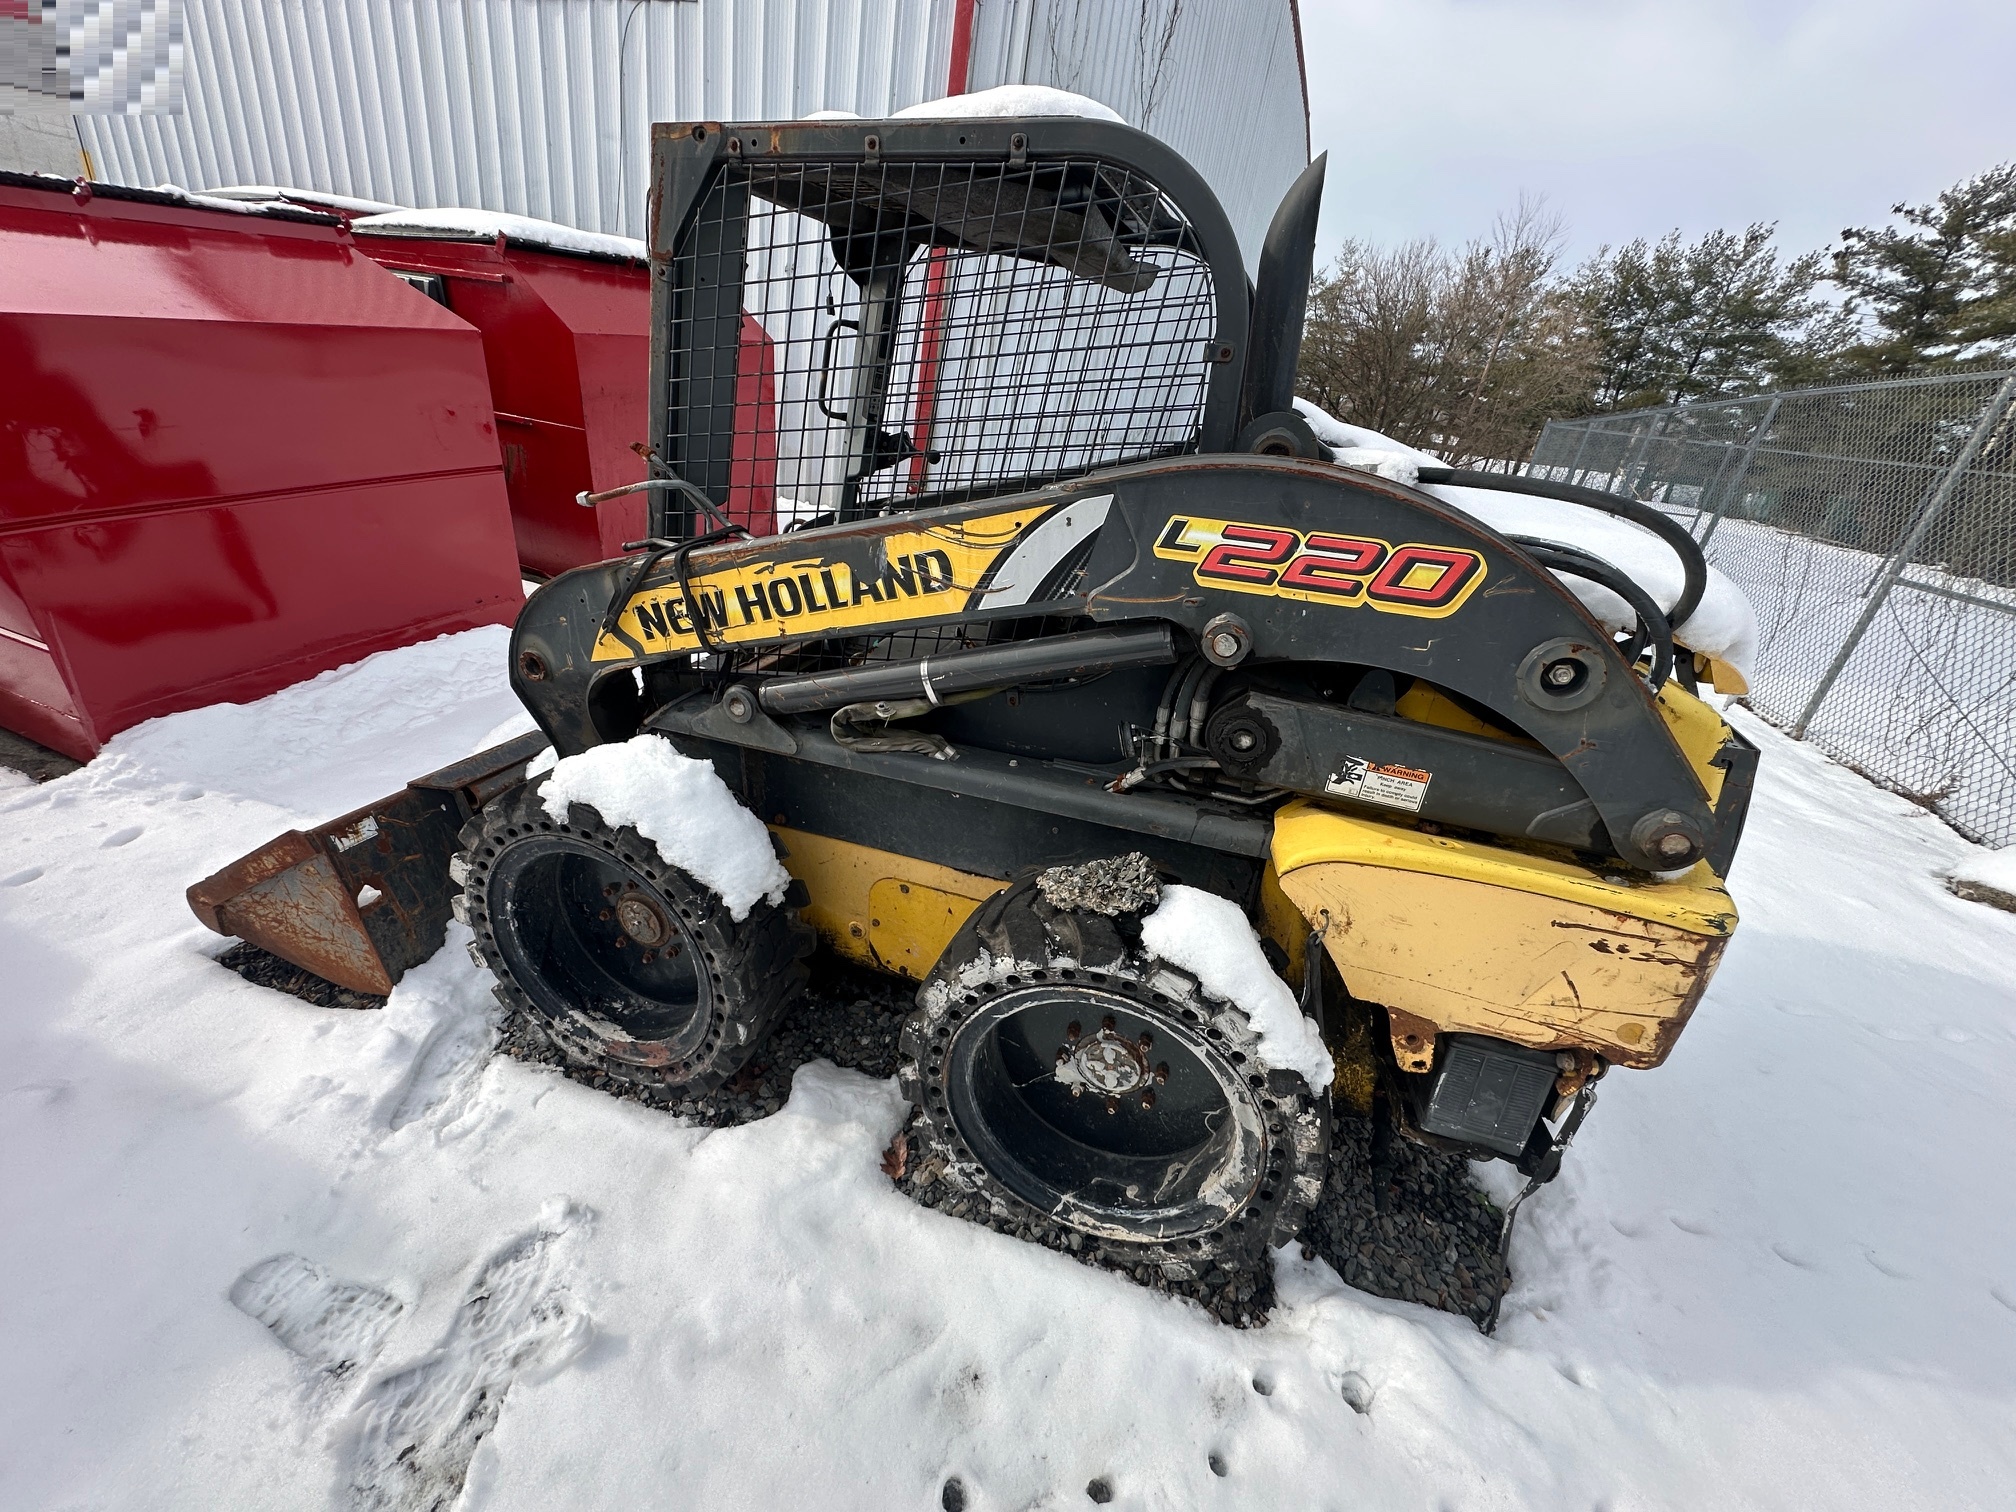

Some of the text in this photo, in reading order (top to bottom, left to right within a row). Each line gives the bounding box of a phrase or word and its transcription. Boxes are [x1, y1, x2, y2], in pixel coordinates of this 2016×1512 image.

[633, 548, 955, 641] NEW HOLLAND
[1155, 517, 1486, 611] L220
[1383, 766, 1424, 780] WARNING
